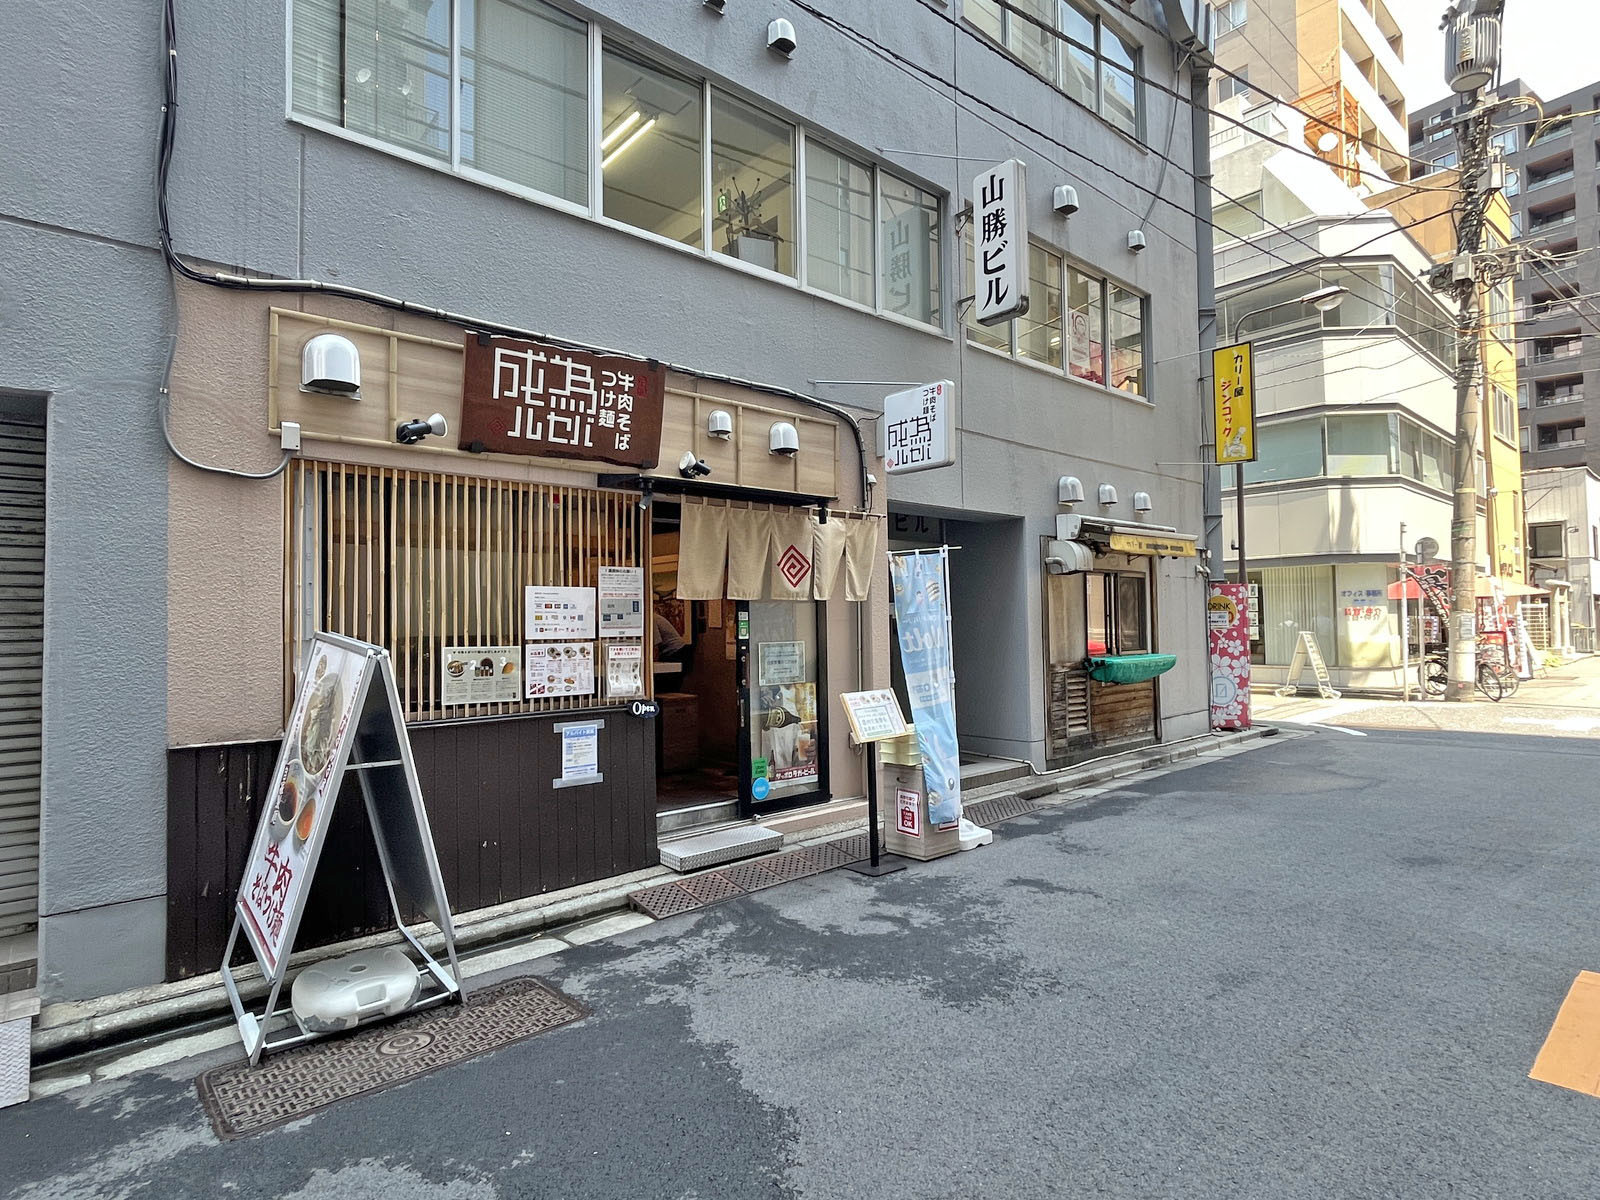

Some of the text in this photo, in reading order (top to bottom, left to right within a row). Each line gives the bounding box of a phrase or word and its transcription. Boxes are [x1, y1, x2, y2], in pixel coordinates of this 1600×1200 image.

[980, 174, 1009, 311] 山勝ビル
[1233, 354, 1245, 398] カリー屋
[598, 370, 617, 428] つけ麺
[615, 370, 635, 451] 牛肉そば
[922, 389, 930, 415] つけ麺
[929, 387, 937, 423] 牛肉そば
[1221, 379, 1233, 438] ジンコック
[1208, 602, 1231, 611] DRINK
[447, 653, 453, 664] 1
[469, 660, 477, 671] 2
[500, 656, 507, 667] 3
[632, 701, 656, 715] Open
[775, 767, 816, 780] サッポロラガービール
[903, 819, 913, 828] OK
[264, 840, 293, 911] 牛肉
[252, 871, 285, 949] そばつけ麺
